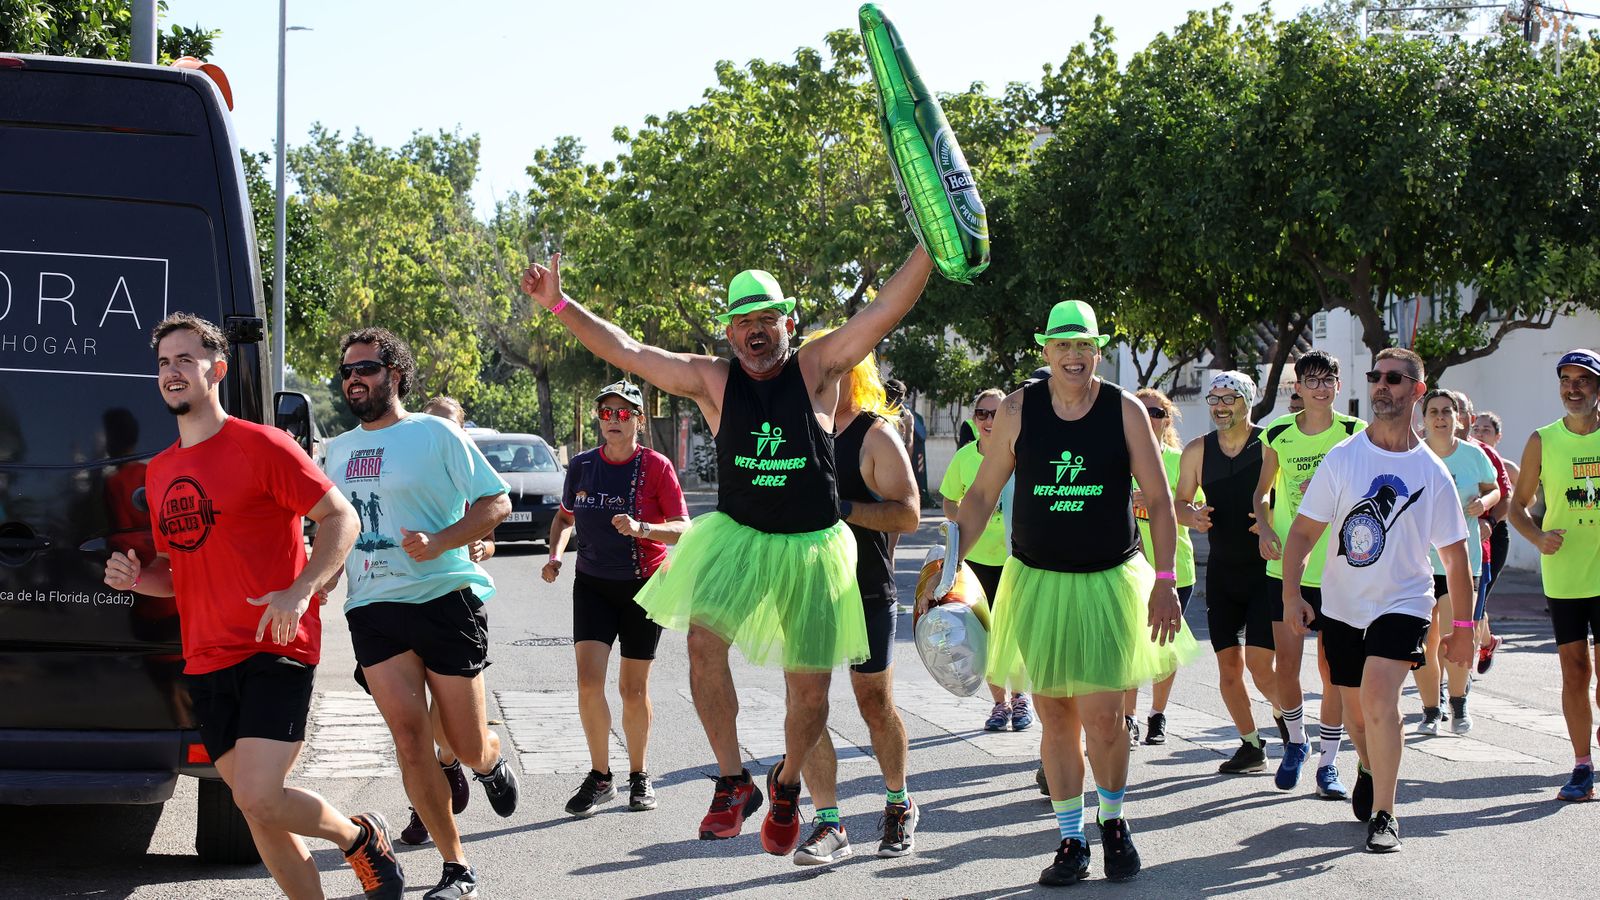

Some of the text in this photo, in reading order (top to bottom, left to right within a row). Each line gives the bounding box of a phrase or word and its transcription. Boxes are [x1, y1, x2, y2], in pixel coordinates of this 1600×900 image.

[0, 270, 142, 330] RA
[2, 334, 97, 356] HOGAR
[346, 457, 382, 478] BARRO
[734, 455, 807, 471] VETE-RUNNERS
[751, 474, 788, 487] JEREZ
[1033, 484, 1104, 497] VETE-RUNNERS
[166, 495, 195, 515] IRON
[1049, 500, 1085, 512] JEREZ
[167, 516, 199, 535] CLUB
[17, 589, 32, 601] de
[35, 590, 46, 602] la
[49, 591, 90, 604] Florida
[93, 592, 135, 607] (Cádiz)
